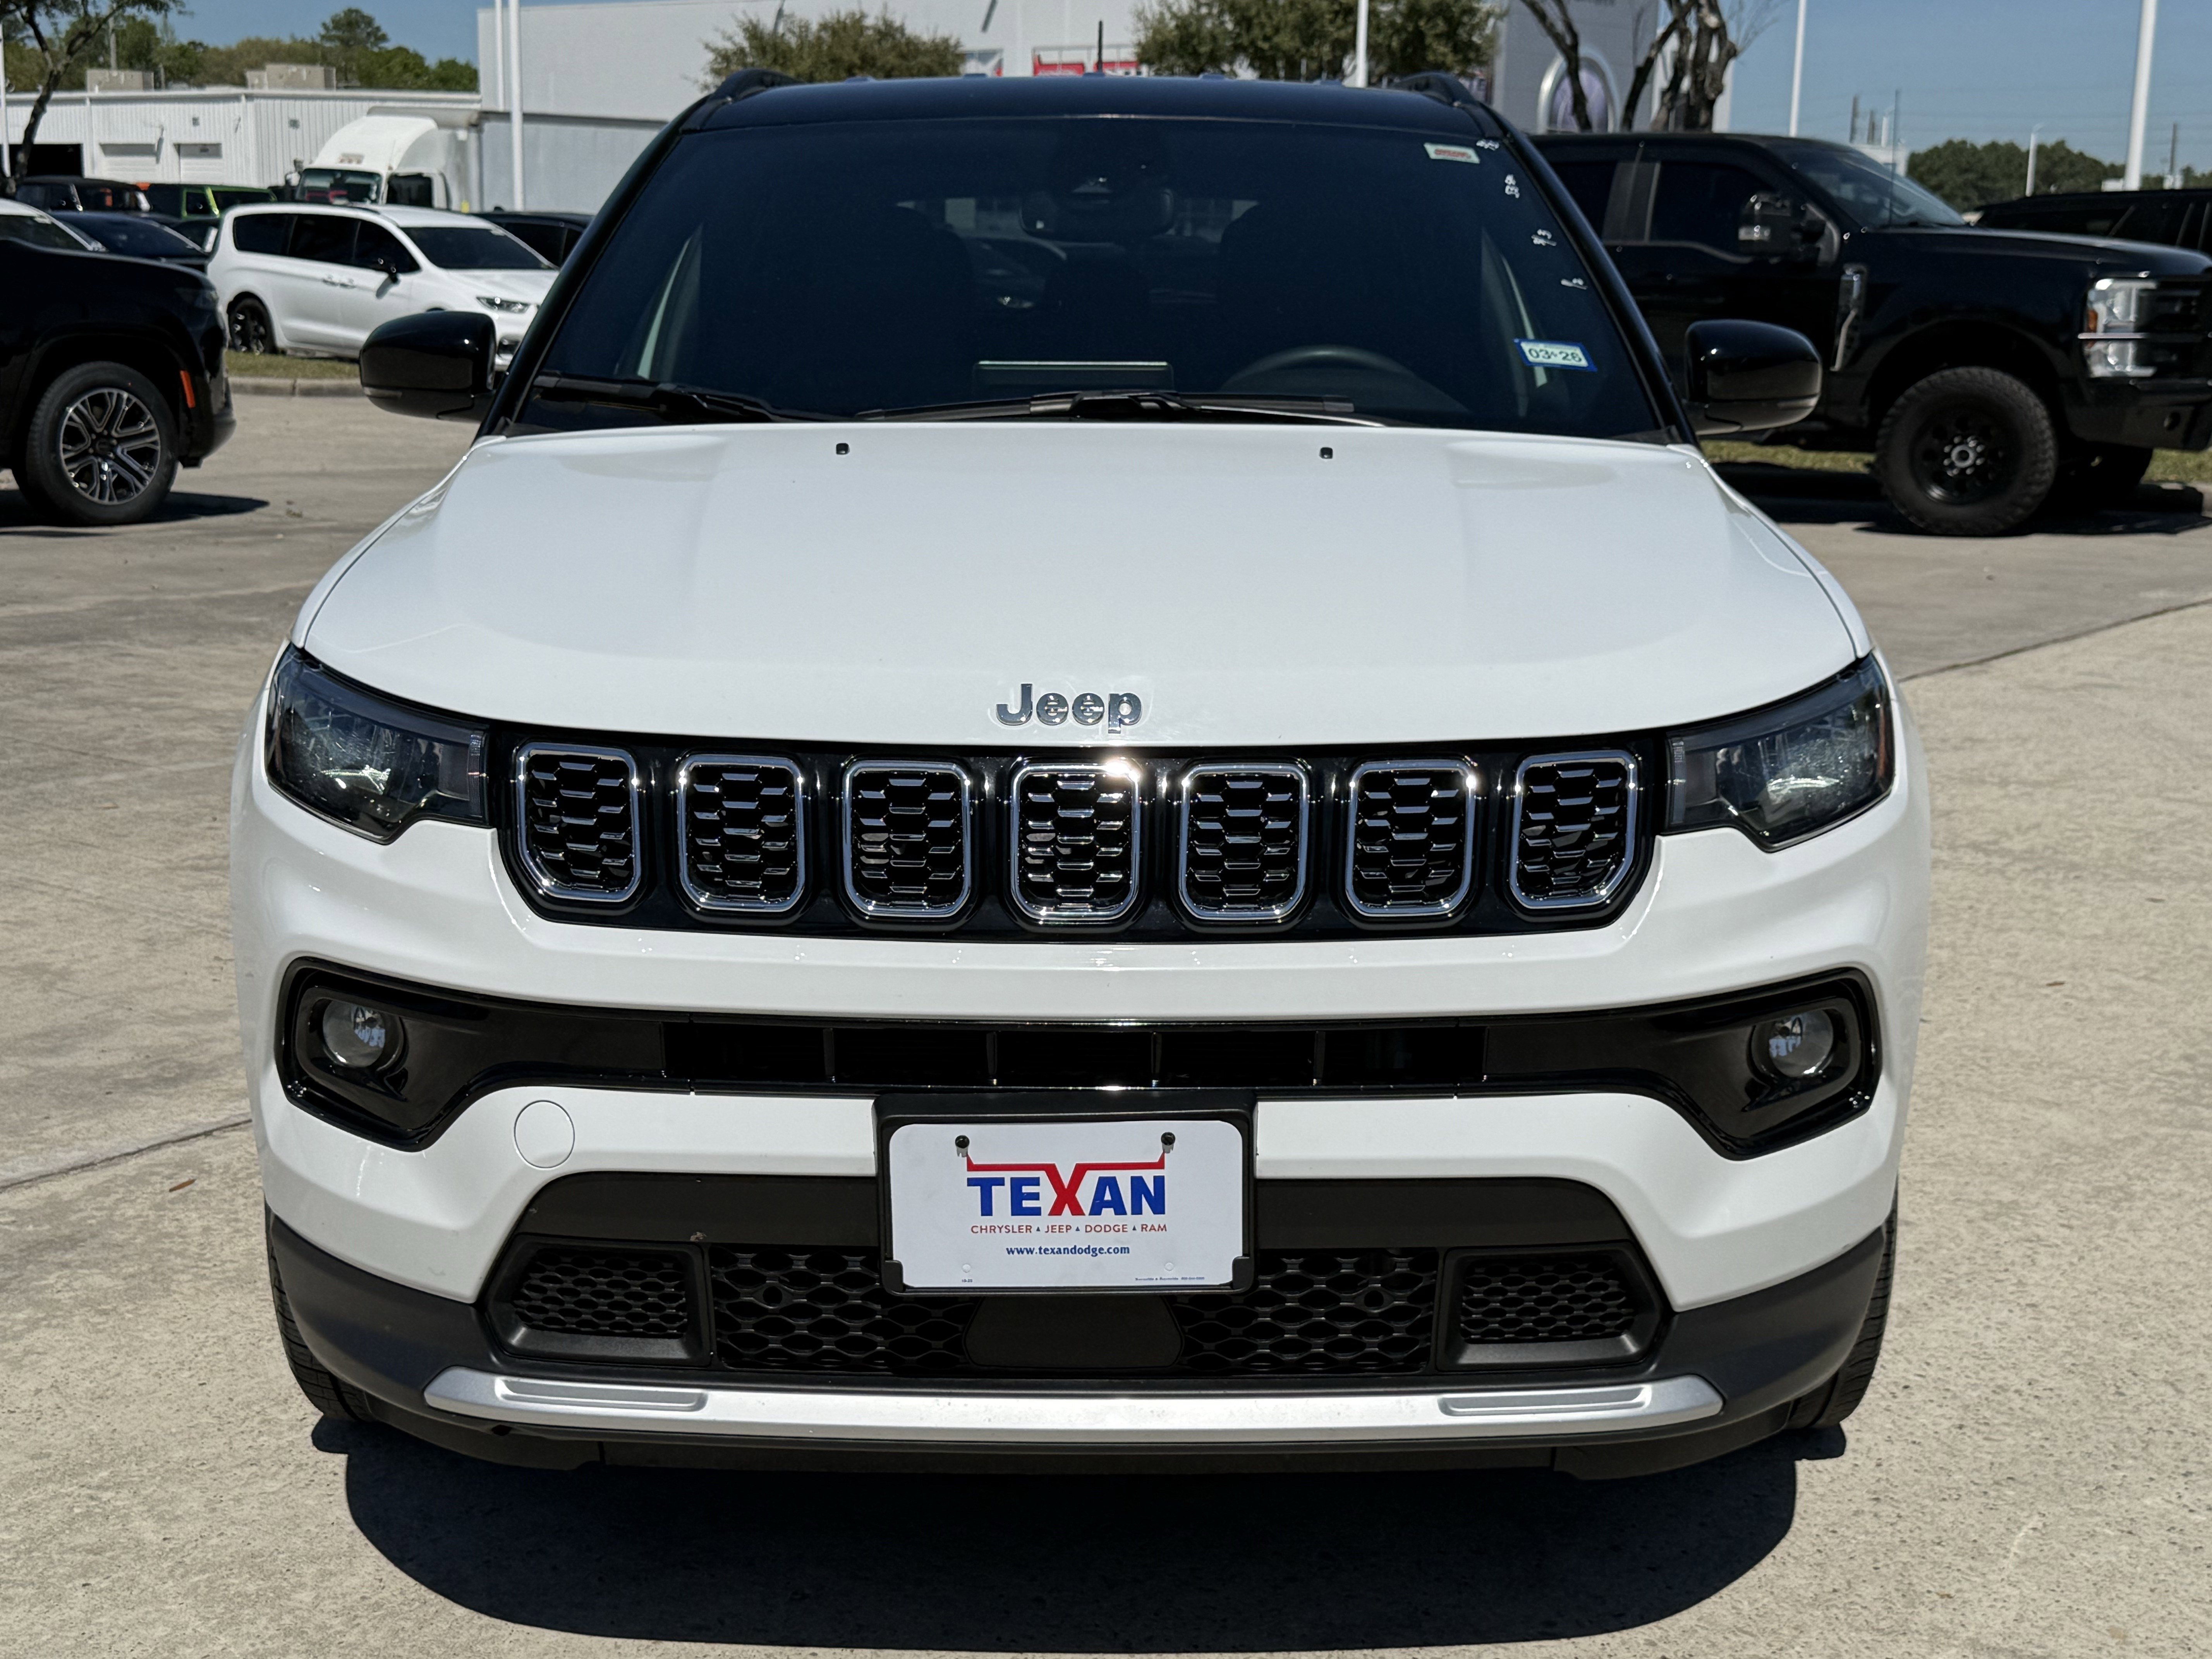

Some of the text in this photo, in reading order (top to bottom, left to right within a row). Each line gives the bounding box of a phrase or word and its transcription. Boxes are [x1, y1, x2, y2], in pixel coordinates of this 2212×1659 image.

[996, 683, 1142, 734] Jeep
[967, 1163, 1165, 1216] TEXAN
[970, 1224, 1167, 1234] CHRYSLER JEEP DODGE RAM
[1006, 1245, 1130, 1257] www.texandodge.com
